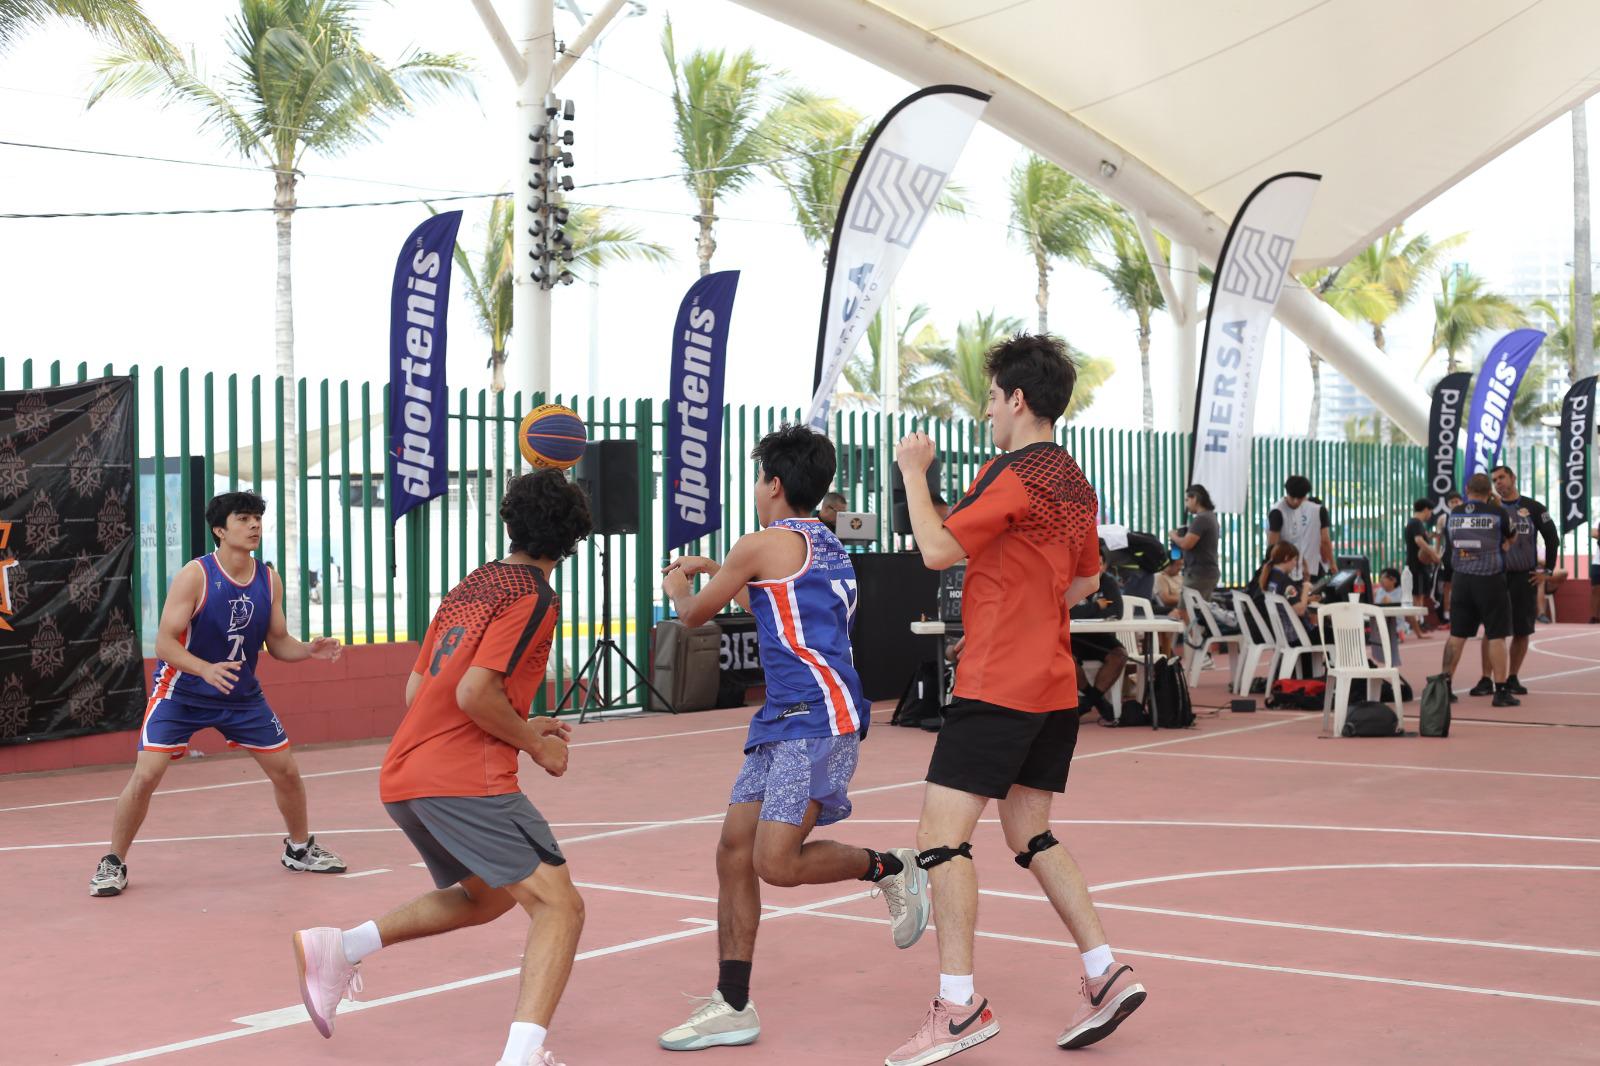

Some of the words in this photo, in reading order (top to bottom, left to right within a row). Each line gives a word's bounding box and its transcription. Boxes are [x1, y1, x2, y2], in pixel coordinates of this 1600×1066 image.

[397, 249, 440, 498] dportenis
[675, 308, 715, 525] dportenis
[1204, 319, 1248, 453] HERSA
[1433, 388, 1460, 494] Onboard
[1566, 394, 1589, 500] Onboard
